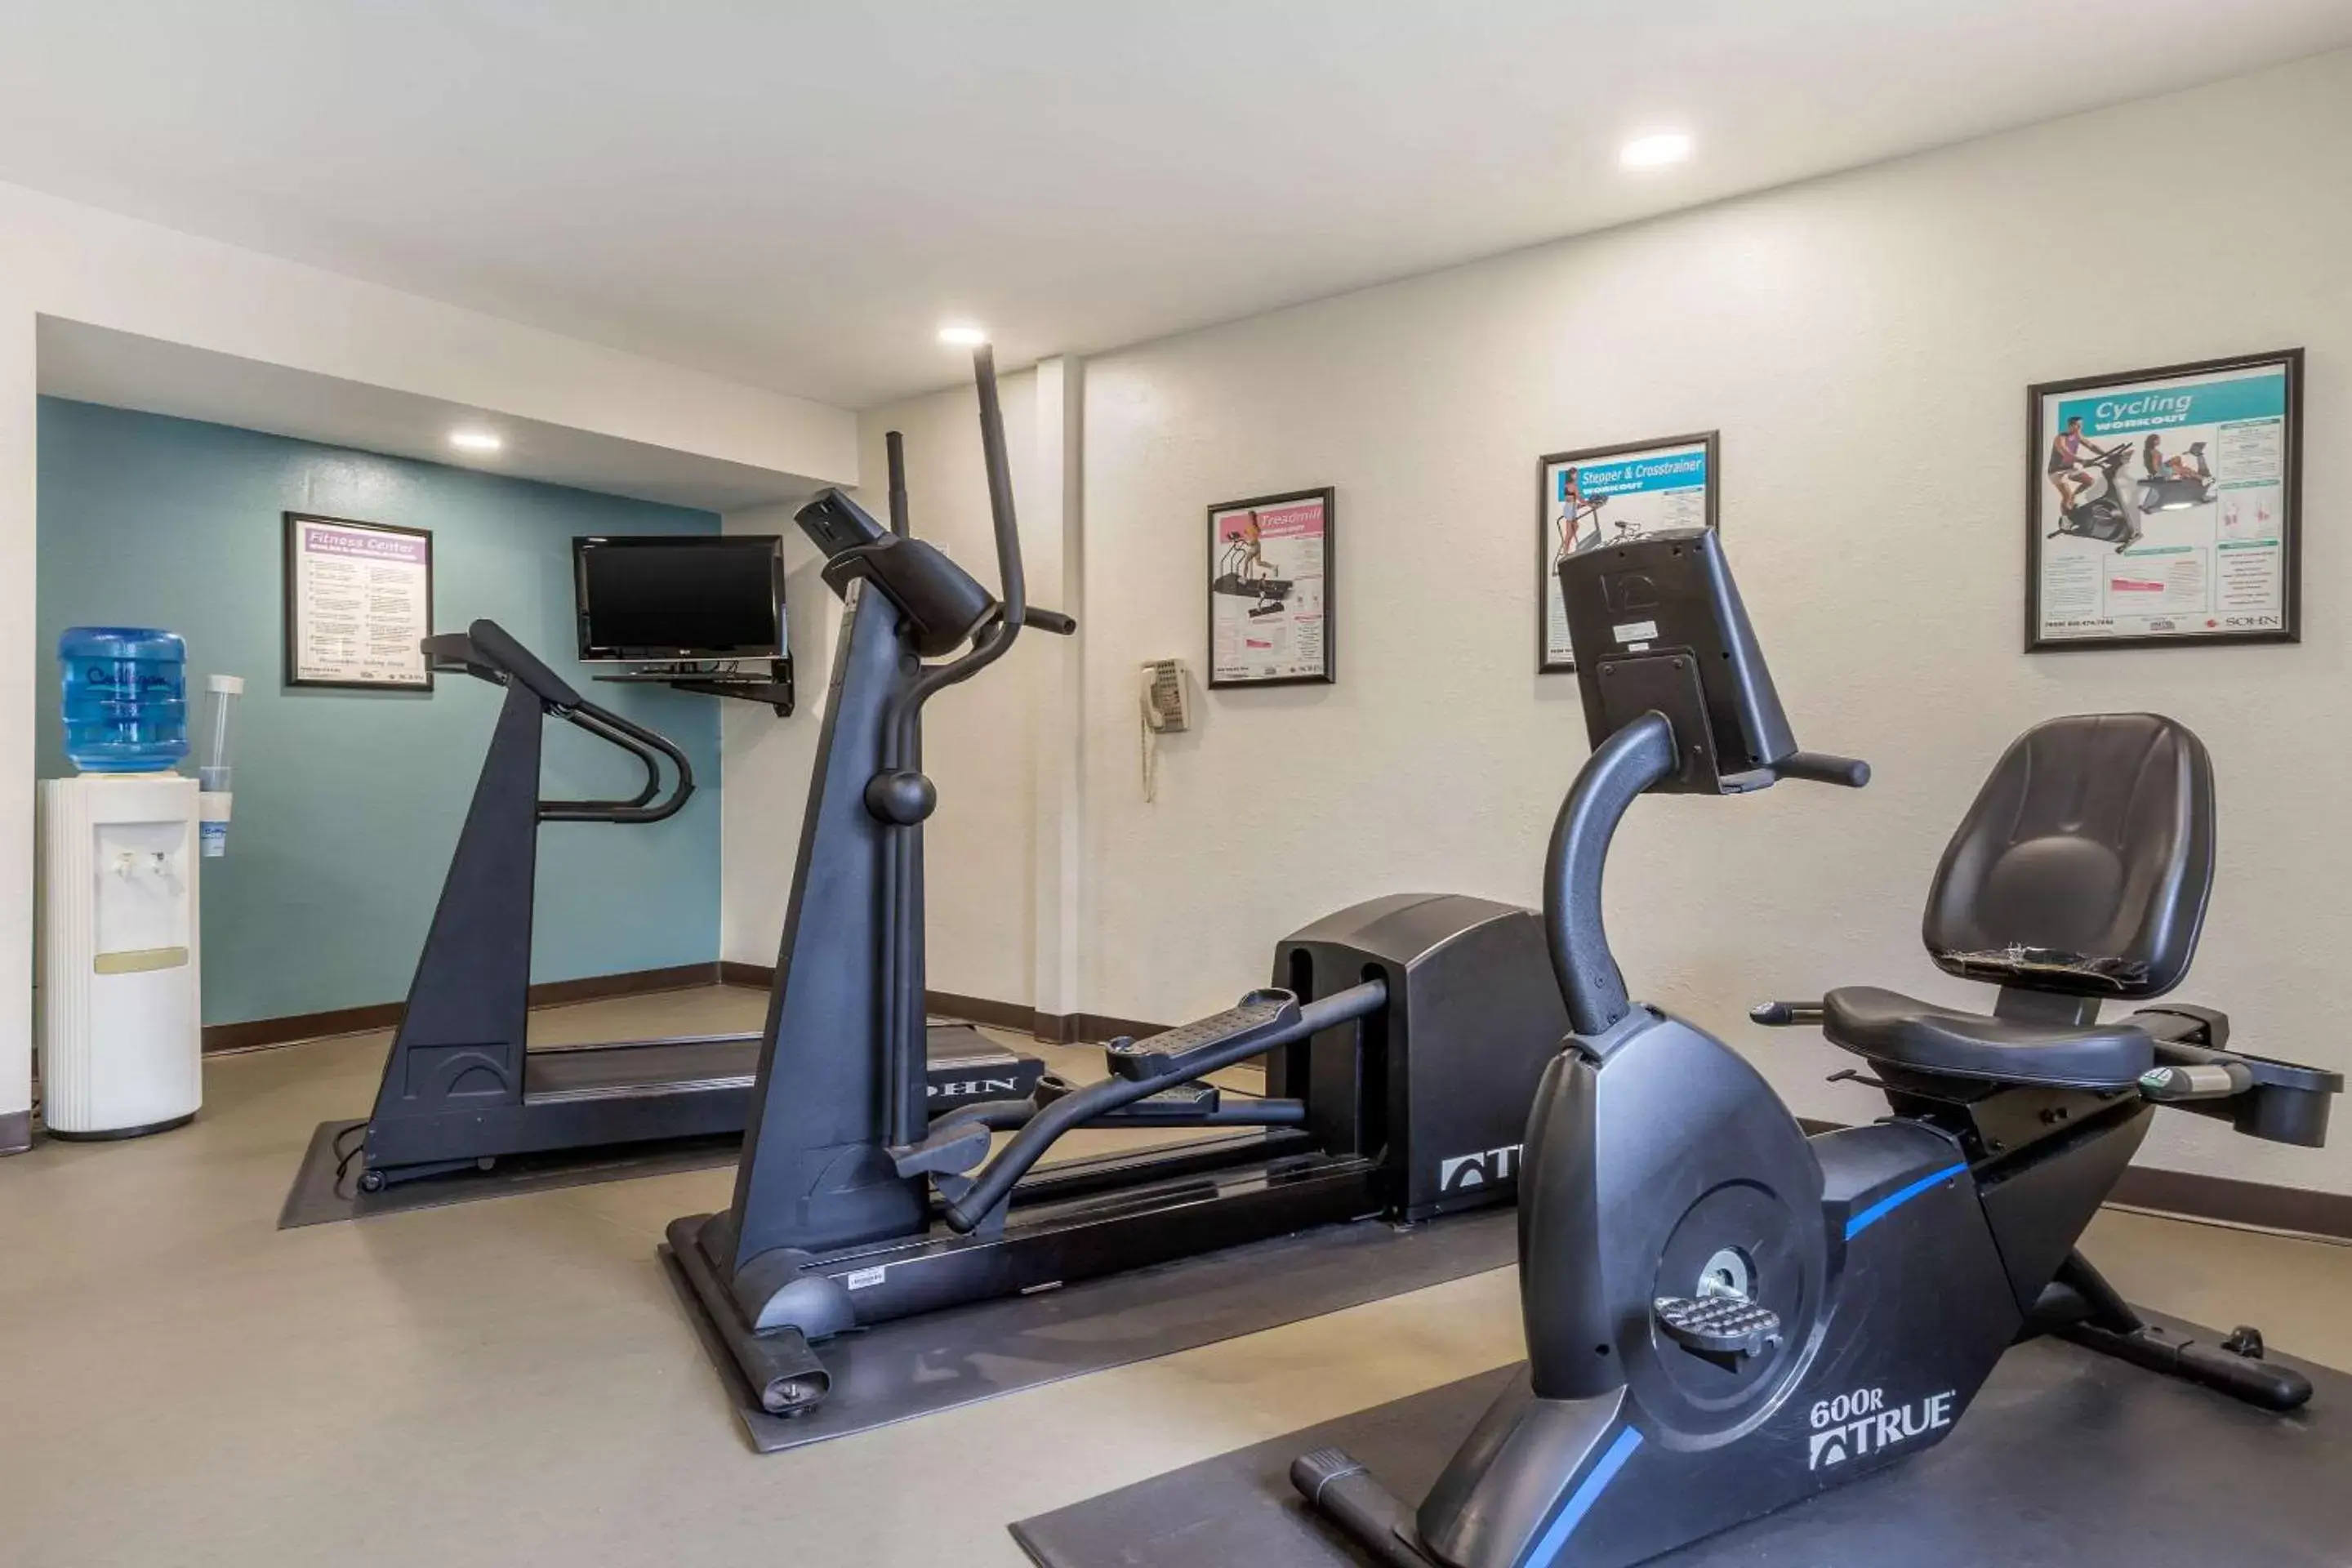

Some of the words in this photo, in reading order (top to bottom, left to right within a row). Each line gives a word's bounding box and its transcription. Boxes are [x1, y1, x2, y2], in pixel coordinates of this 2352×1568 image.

[2096, 395, 2193, 420] Cycling
[2095, 413, 2187, 431] WORKOUT
[1583, 470, 1621, 485] Stepper
[1624, 466, 1633, 479] &
[1636, 459, 1702, 478] Crosstrainer
[1263, 507, 1321, 526] Treadmill
[310, 532, 364, 547] Fitness
[367, 539, 415, 553] Center
[1810, 1388, 1883, 1428] 600R
[1848, 1392, 1951, 1454] TRUE
